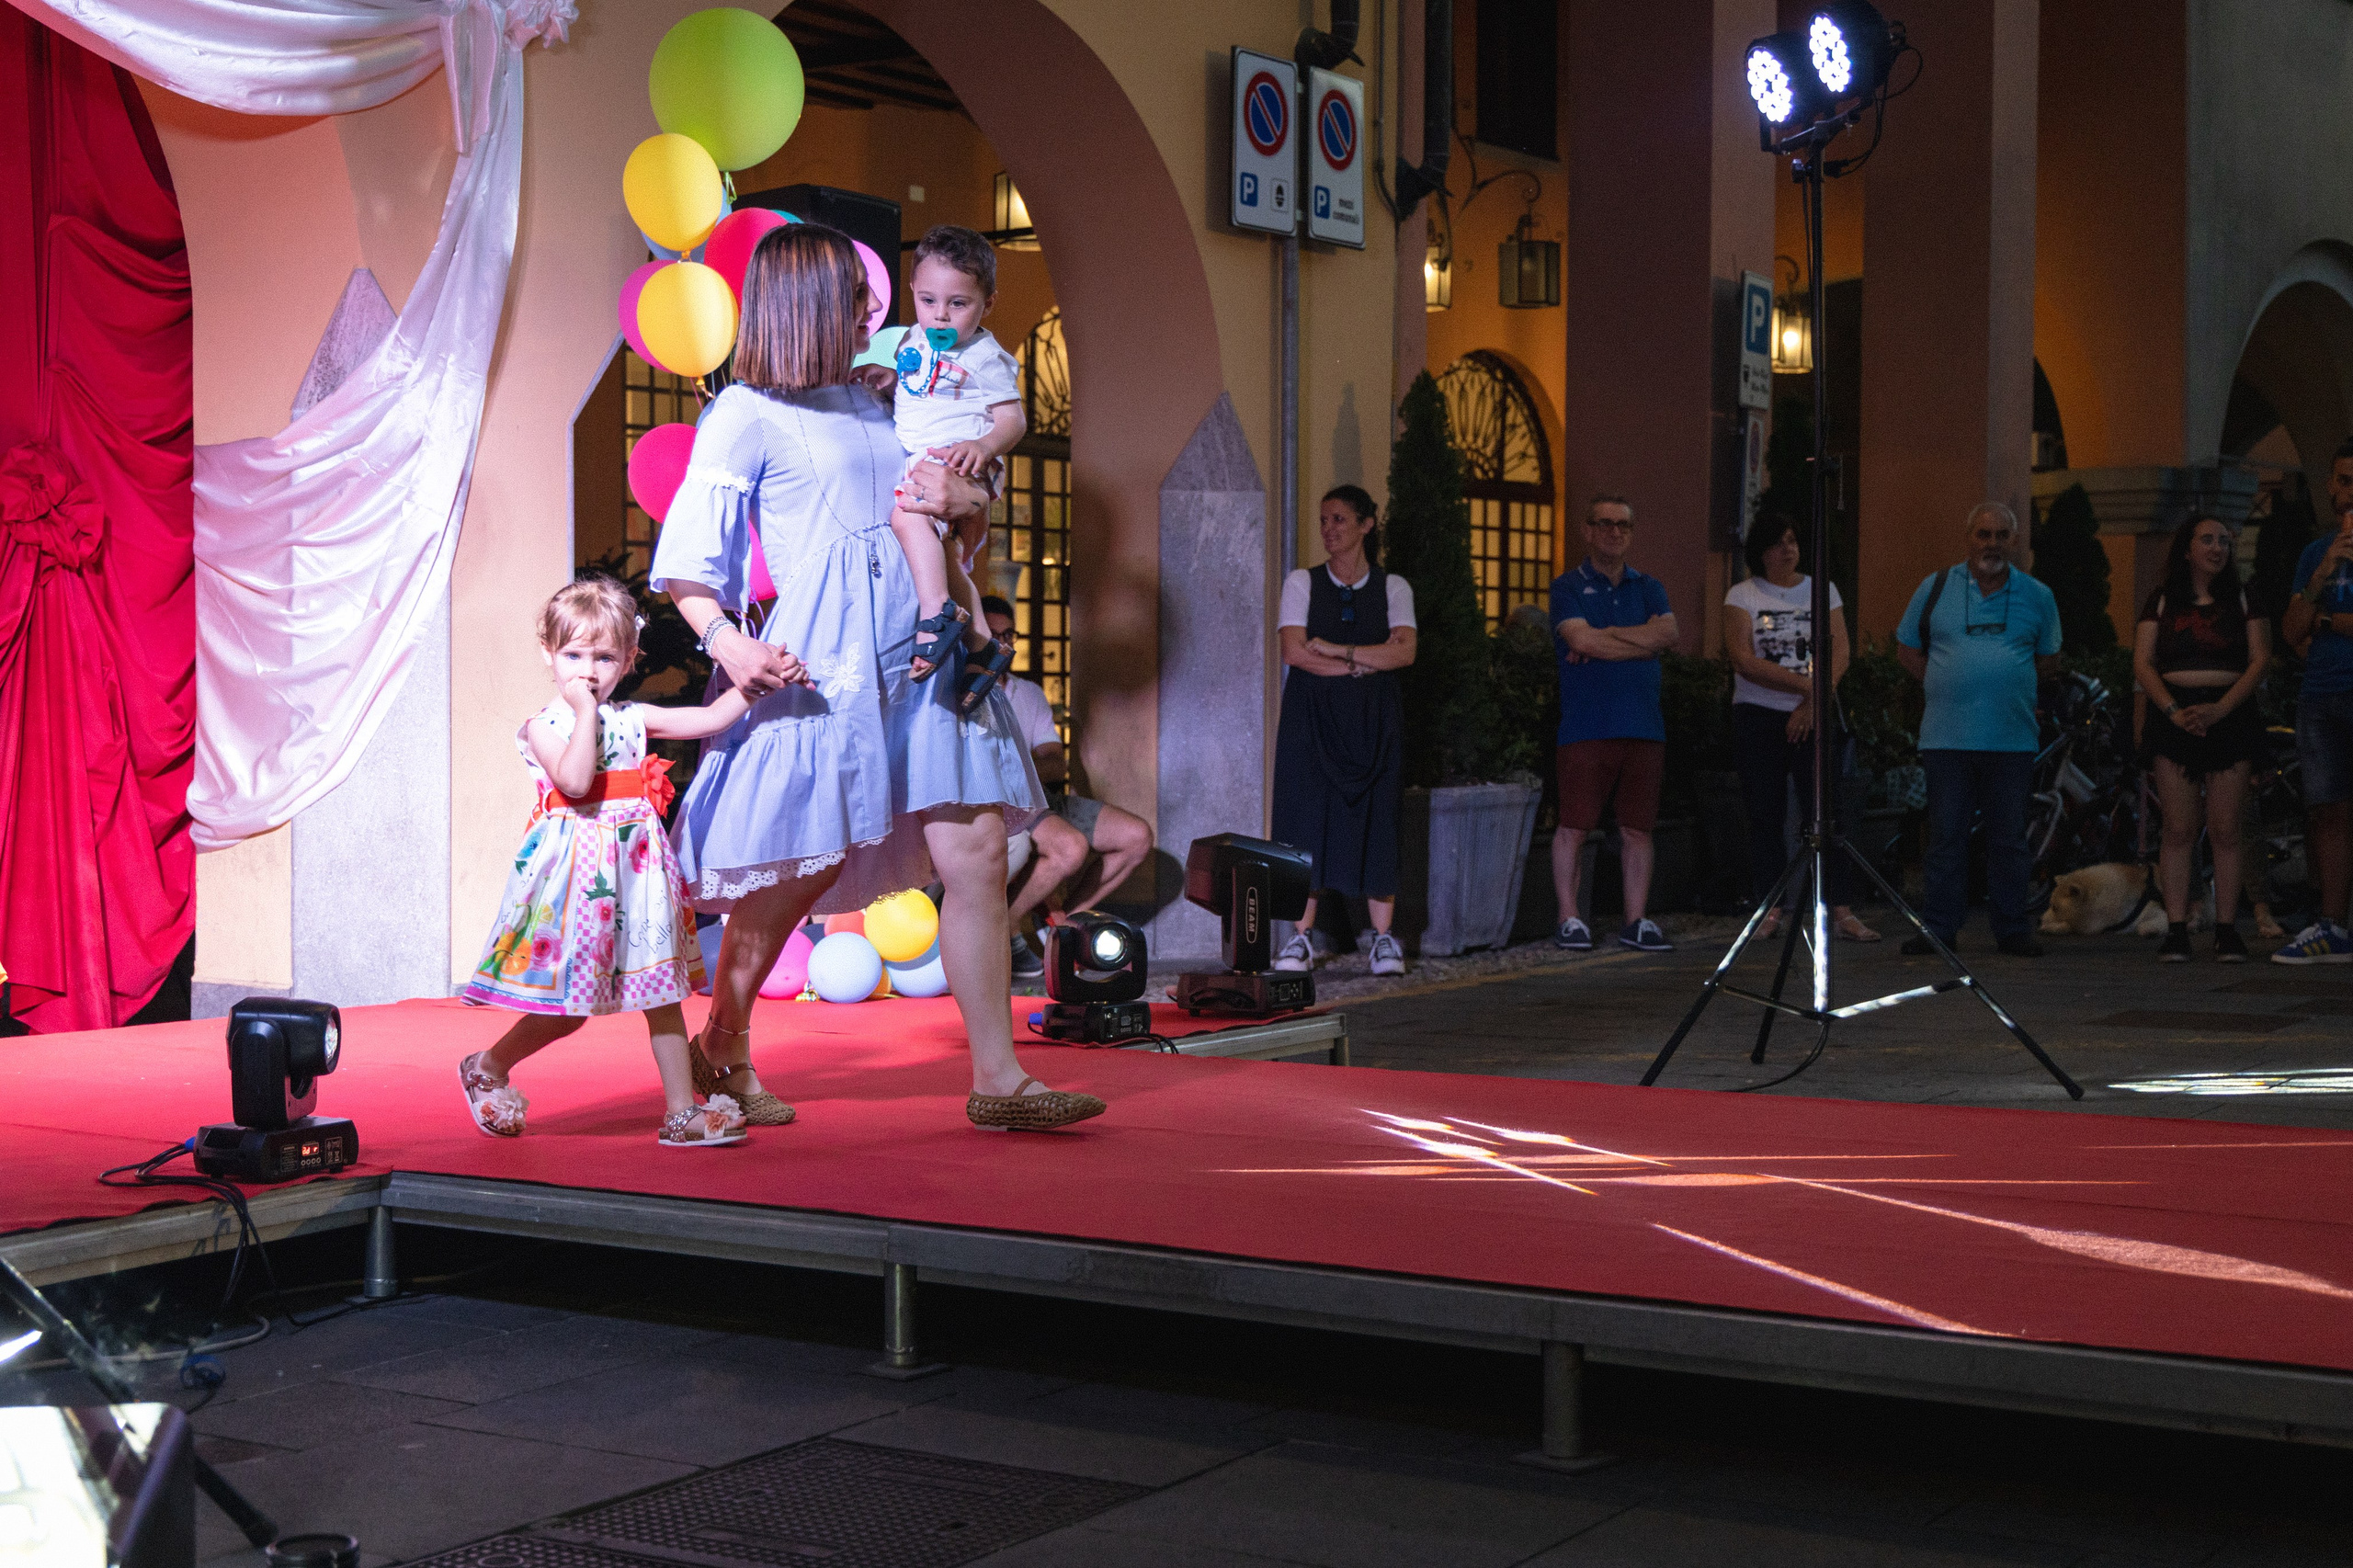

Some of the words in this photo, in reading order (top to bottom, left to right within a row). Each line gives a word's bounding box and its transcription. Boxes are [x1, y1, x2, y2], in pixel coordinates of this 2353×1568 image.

[1243, 176, 1255, 202] P
[1316, 189, 1327, 213] P
[1750, 293, 1766, 344] P
